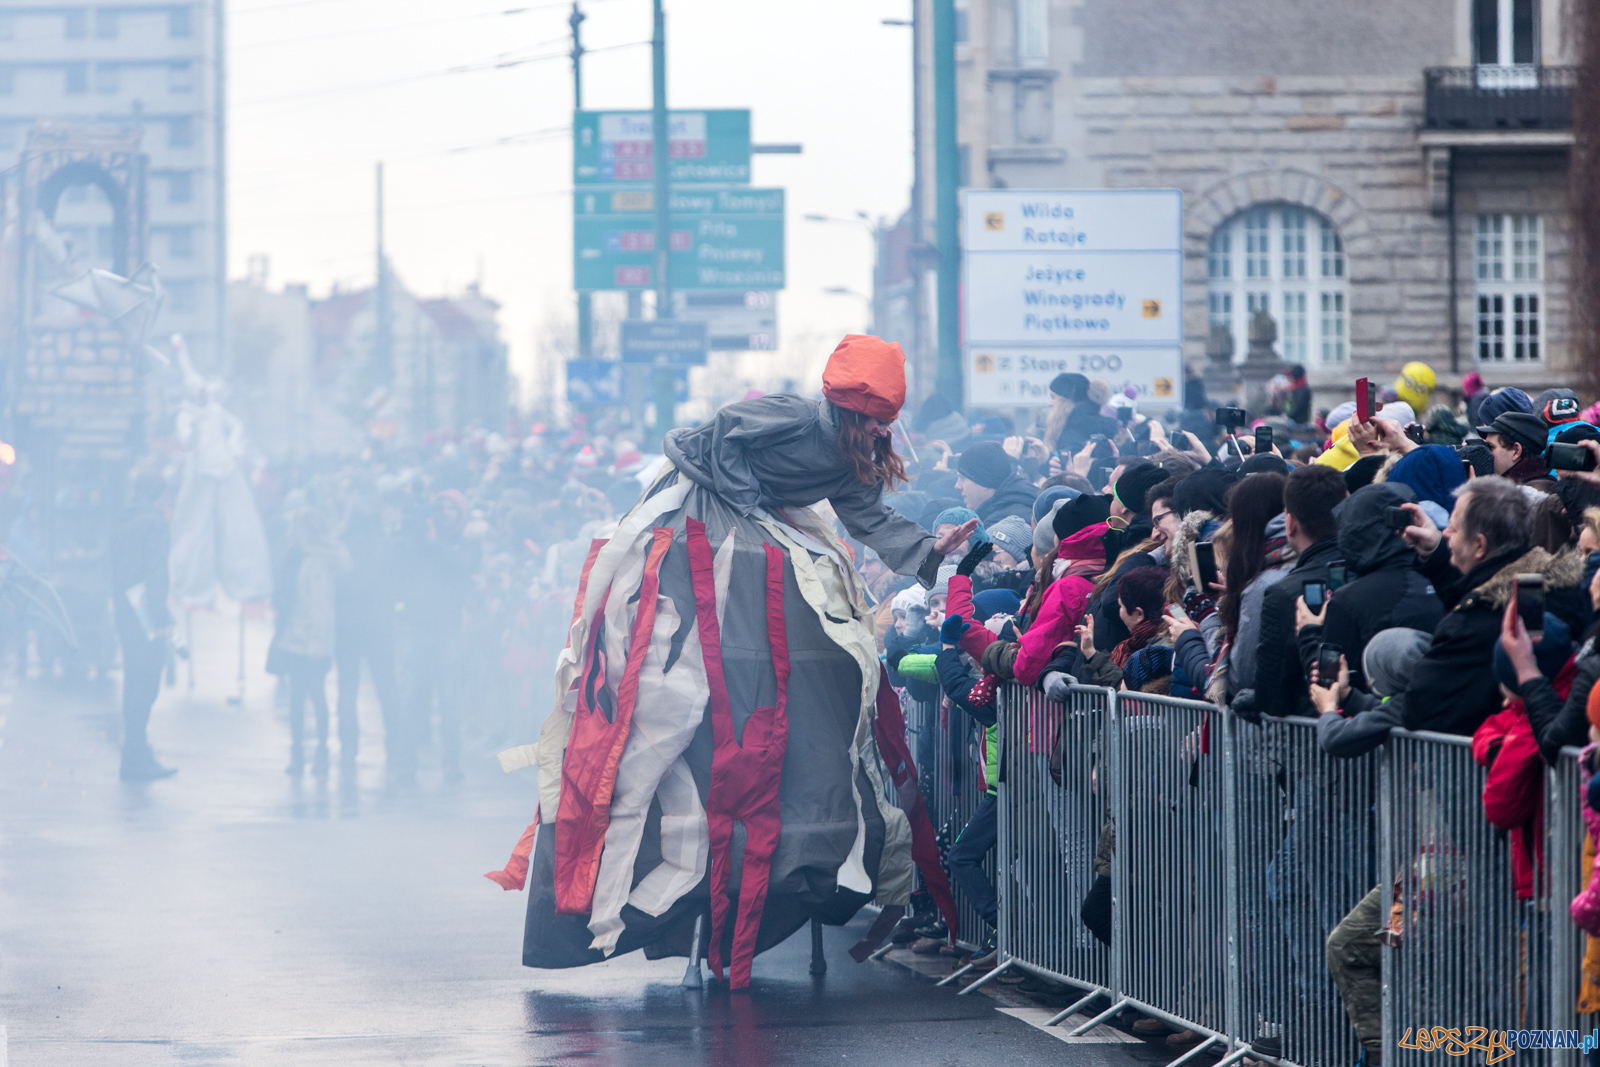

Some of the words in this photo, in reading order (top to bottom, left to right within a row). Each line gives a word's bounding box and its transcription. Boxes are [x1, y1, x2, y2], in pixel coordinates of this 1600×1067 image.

[1021, 203, 1075, 219] Wilda
[1022, 227, 1087, 246] Rataje
[1025, 265, 1086, 285] Jeżyce
[1023, 290, 1126, 310] Winogrady
[1023, 313, 1111, 332] Piątkowo
[1020, 355, 1068, 372] Stare
[1078, 354, 1123, 372] ZOO
